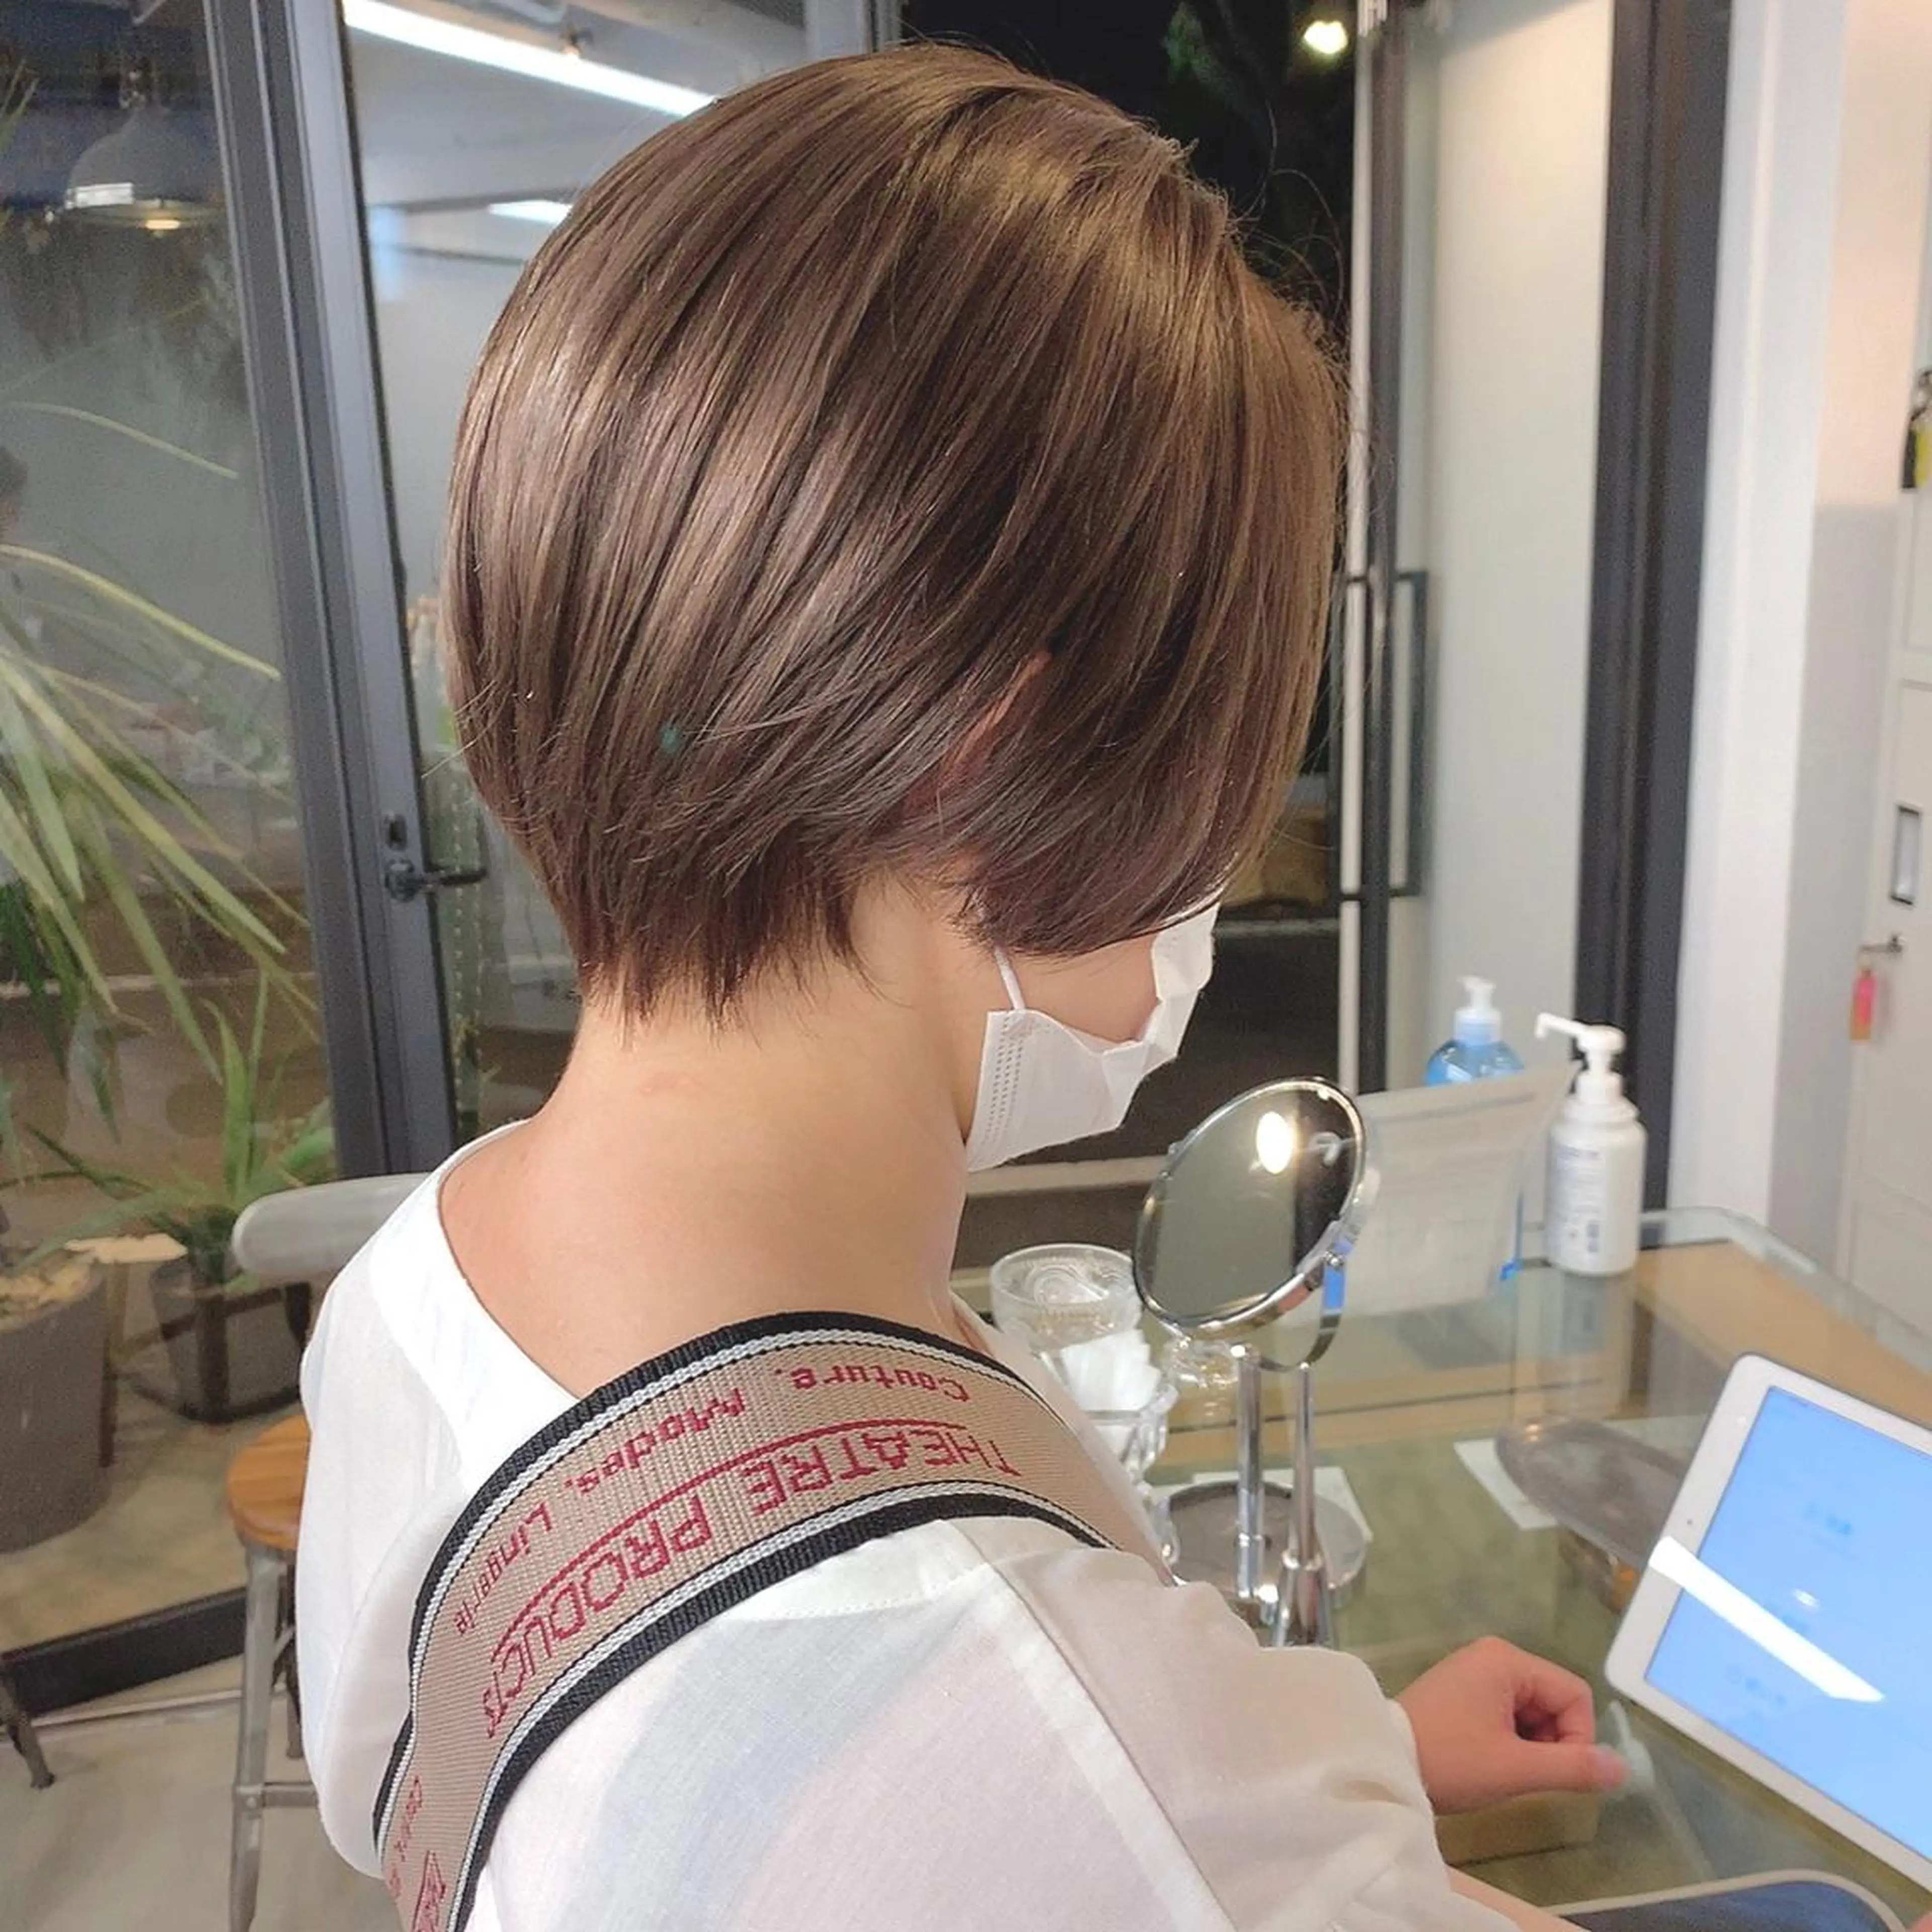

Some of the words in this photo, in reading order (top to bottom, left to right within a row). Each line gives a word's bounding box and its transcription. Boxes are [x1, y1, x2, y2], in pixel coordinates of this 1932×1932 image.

[775, 1365, 969, 1402] Couture.
[566, 1388, 745, 1495] Modes.
[743, 1428, 1021, 1516] THEATRE
[482, 1496, 712, 1738] PRODUCTS
